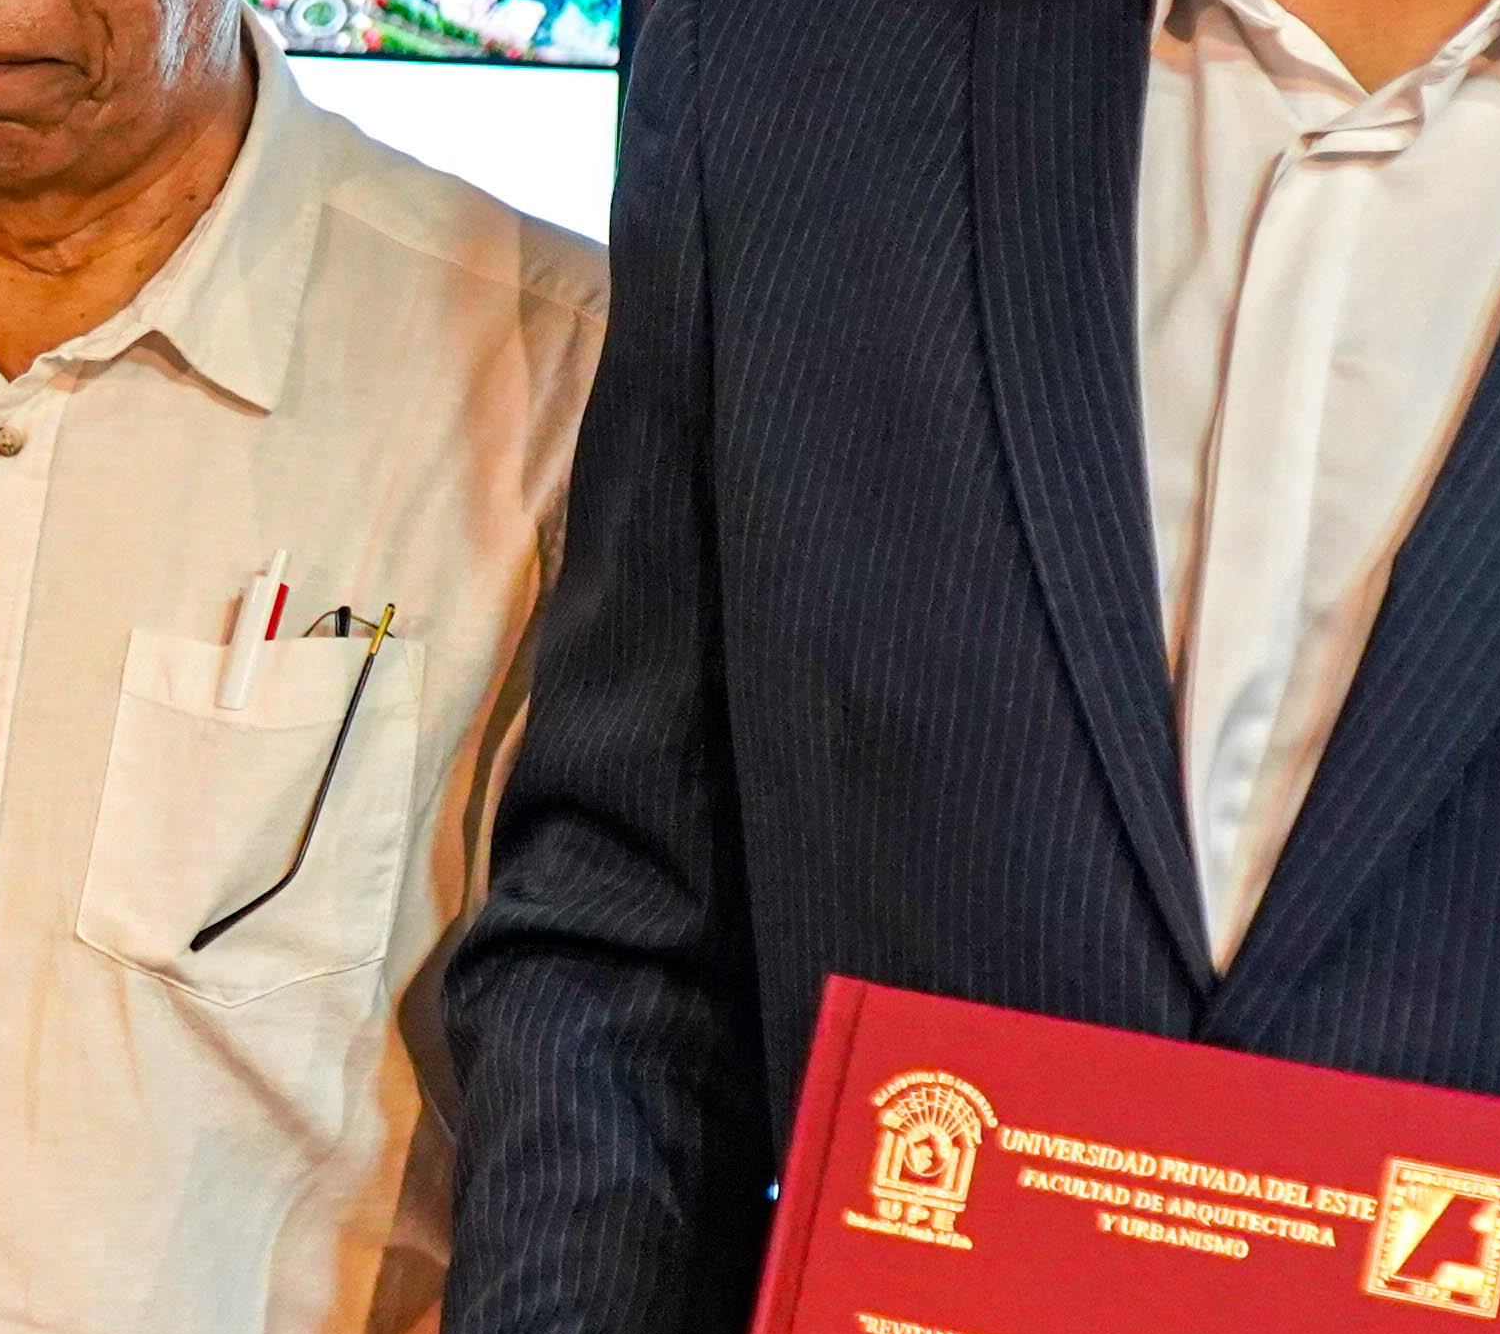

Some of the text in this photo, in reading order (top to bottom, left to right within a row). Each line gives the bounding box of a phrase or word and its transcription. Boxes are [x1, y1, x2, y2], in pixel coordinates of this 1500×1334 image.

[1000, 1127, 1376, 1221] UNIVERSIDAD PRIVADA DEL ESTE
[877, 1198, 957, 1233] UPE
[1020, 1168, 1336, 1247] FACULTAD DE ARQUITECTURA
[1099, 1212, 1249, 1258] Y URBANISMO
